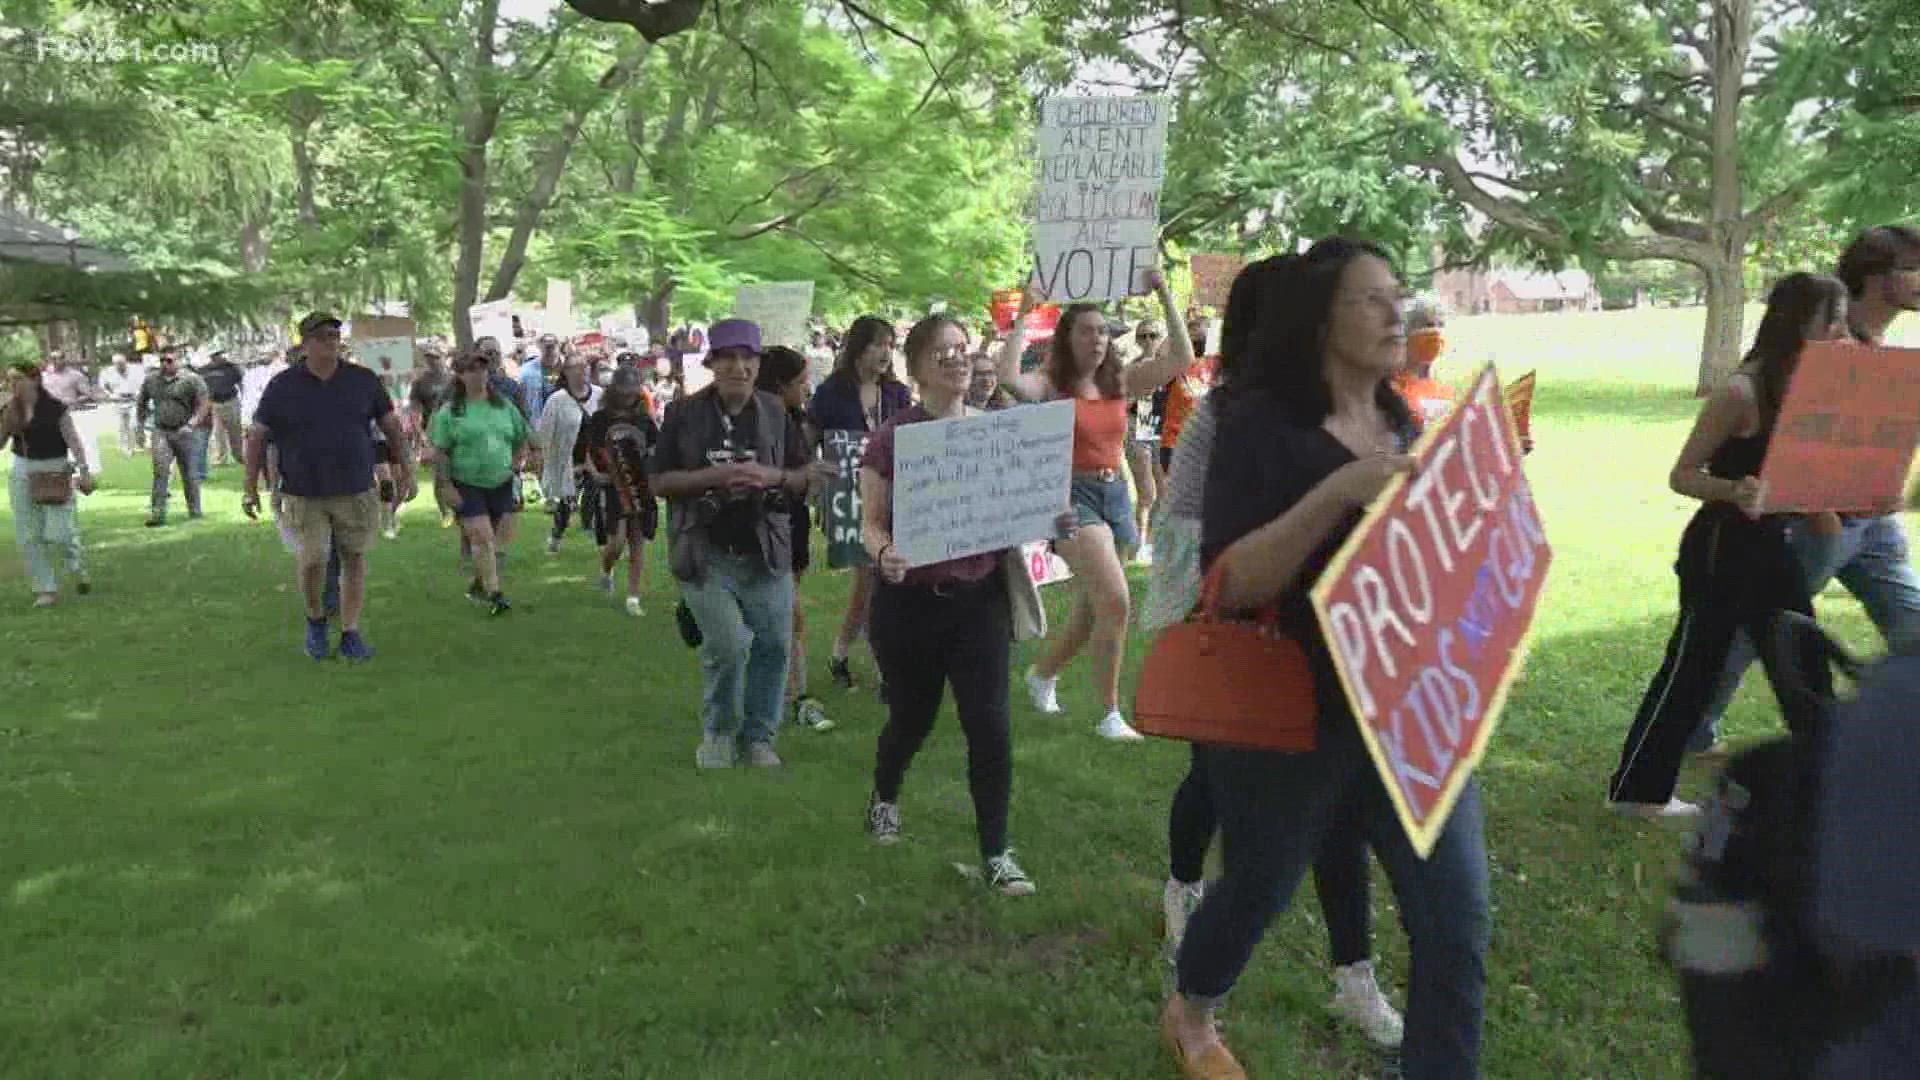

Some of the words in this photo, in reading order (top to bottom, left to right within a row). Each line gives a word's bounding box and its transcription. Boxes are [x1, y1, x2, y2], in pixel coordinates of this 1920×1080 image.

[1056, 101, 1158, 124] CHILDREN
[1035, 246, 1153, 302] VOTE
[1330, 366, 1512, 720] PROTECT
[1378, 626, 1480, 822] KIDS
